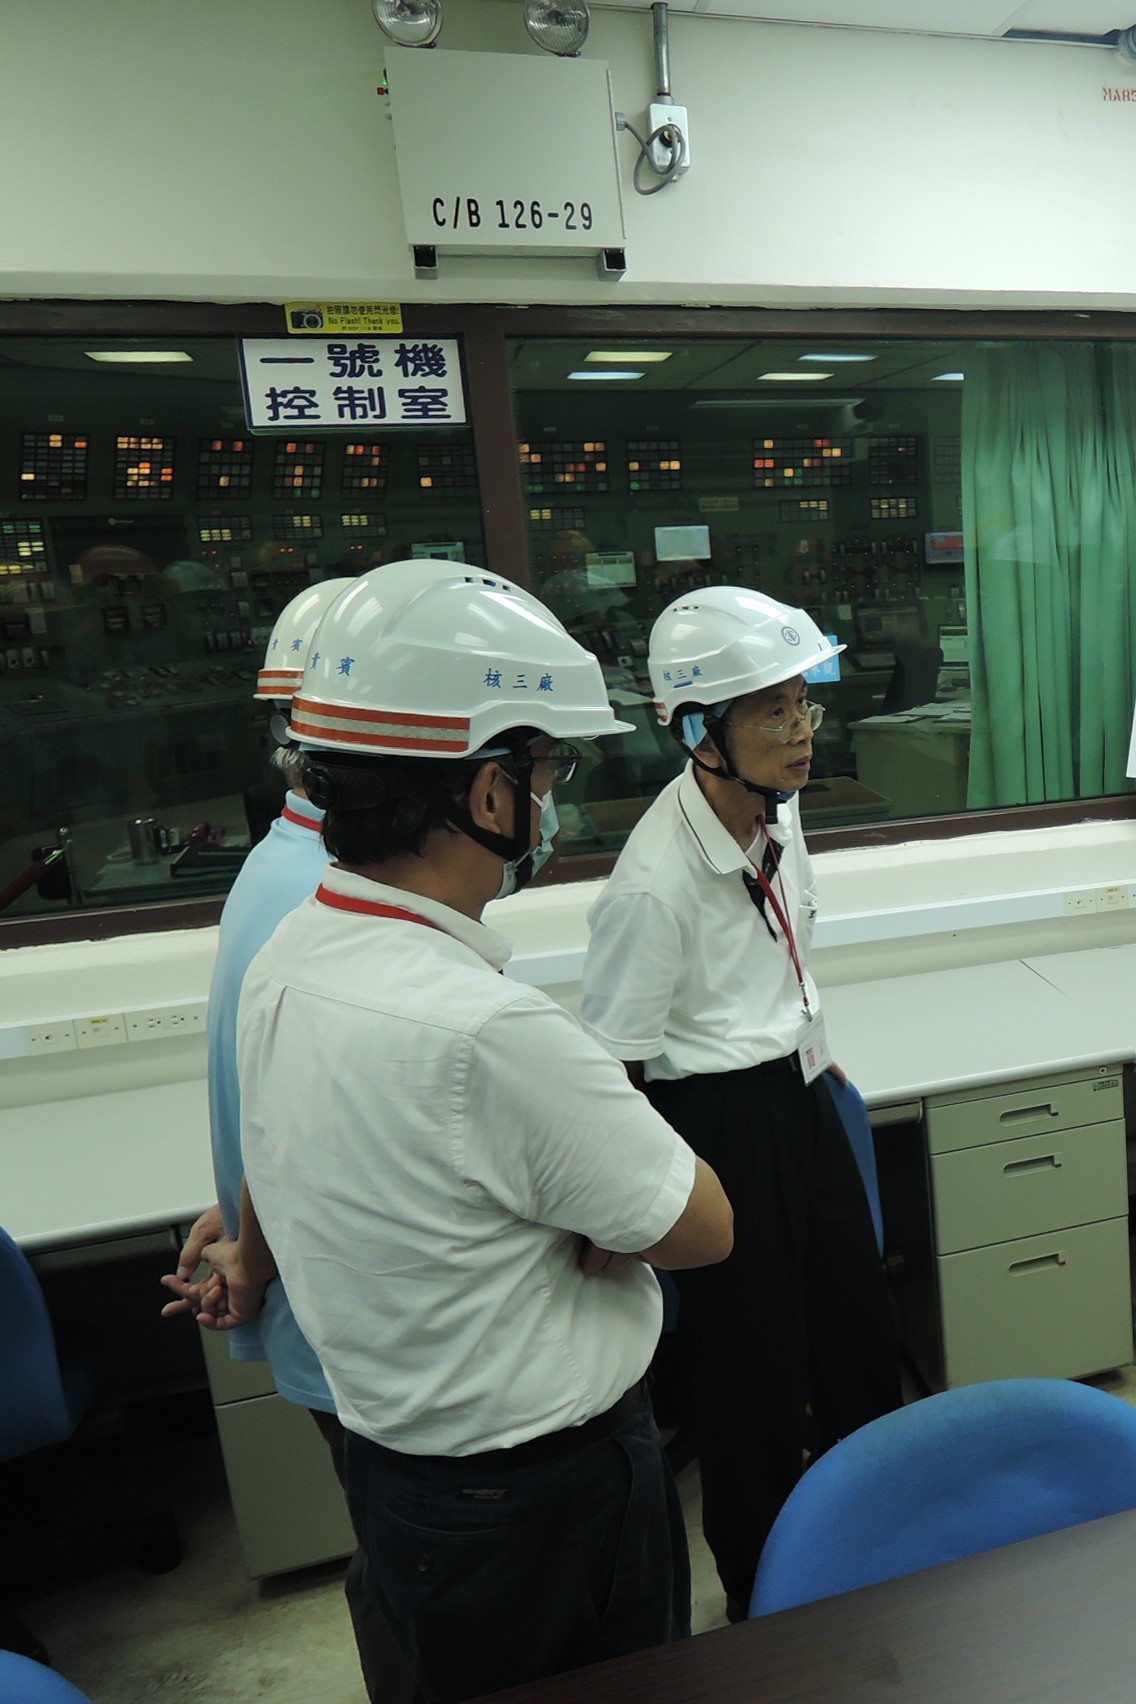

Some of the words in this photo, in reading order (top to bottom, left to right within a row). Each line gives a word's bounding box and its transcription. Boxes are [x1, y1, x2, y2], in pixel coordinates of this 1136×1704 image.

[432, 196, 481, 229] C/B
[495, 199, 593, 231] 126-29
[259, 343, 448, 378] 一號機
[264, 385, 452, 422] 控制室
[482, 667, 554, 692] 核三廠
